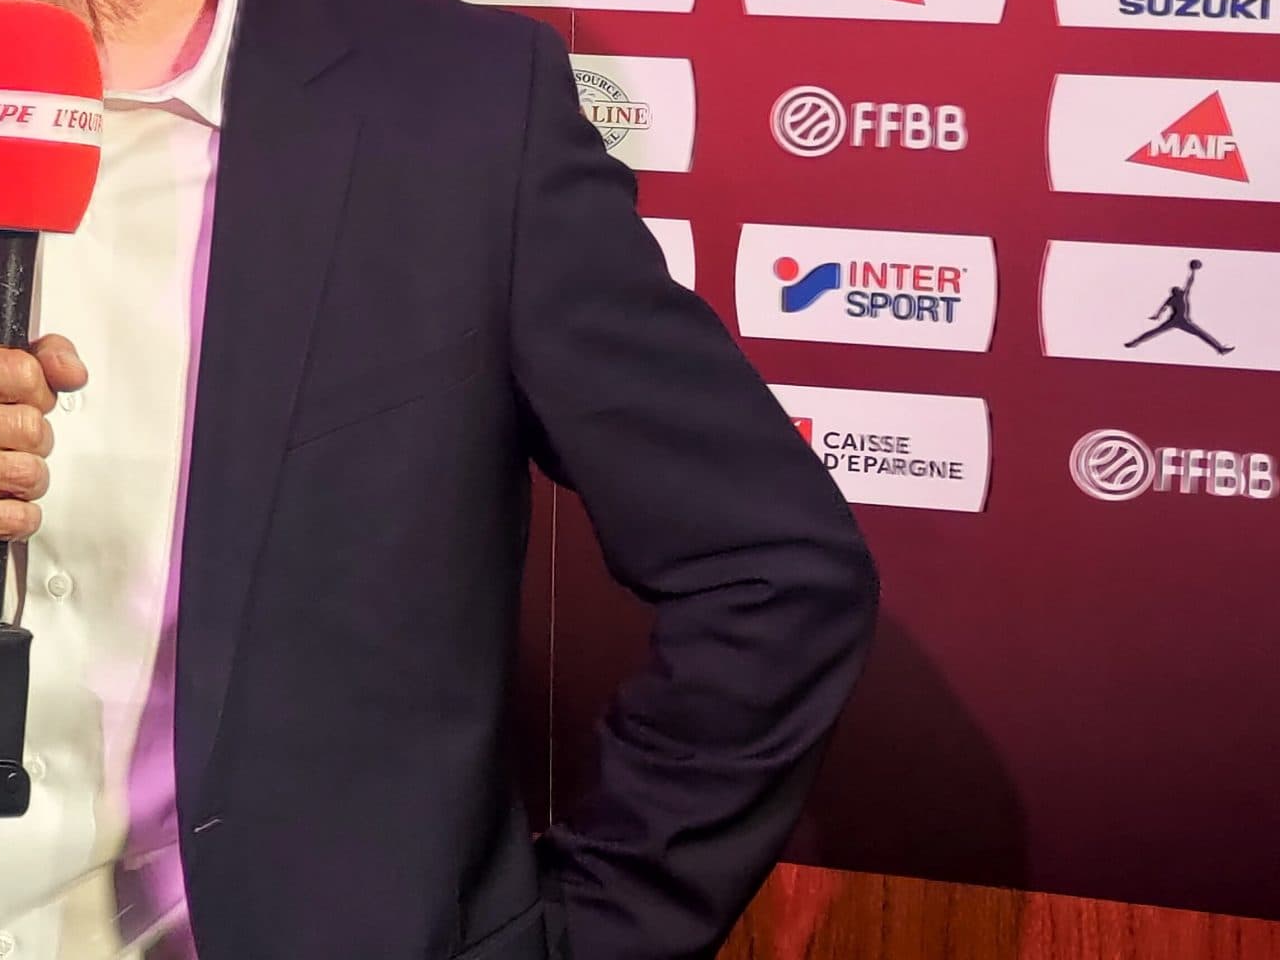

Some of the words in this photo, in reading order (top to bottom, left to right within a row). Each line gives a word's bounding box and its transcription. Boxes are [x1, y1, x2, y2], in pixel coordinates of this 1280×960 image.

[575, 73, 622, 100] SOURCE
[850, 102, 968, 151] FFBB
[1149, 133, 1235, 161] MAIF
[849, 261, 961, 294] INTER
[846, 290, 961, 323] SPORT
[823, 432, 911, 454] CAISSE
[822, 453, 964, 480] D'EPARGNE
[1153, 447, 1278, 499] FFBB
